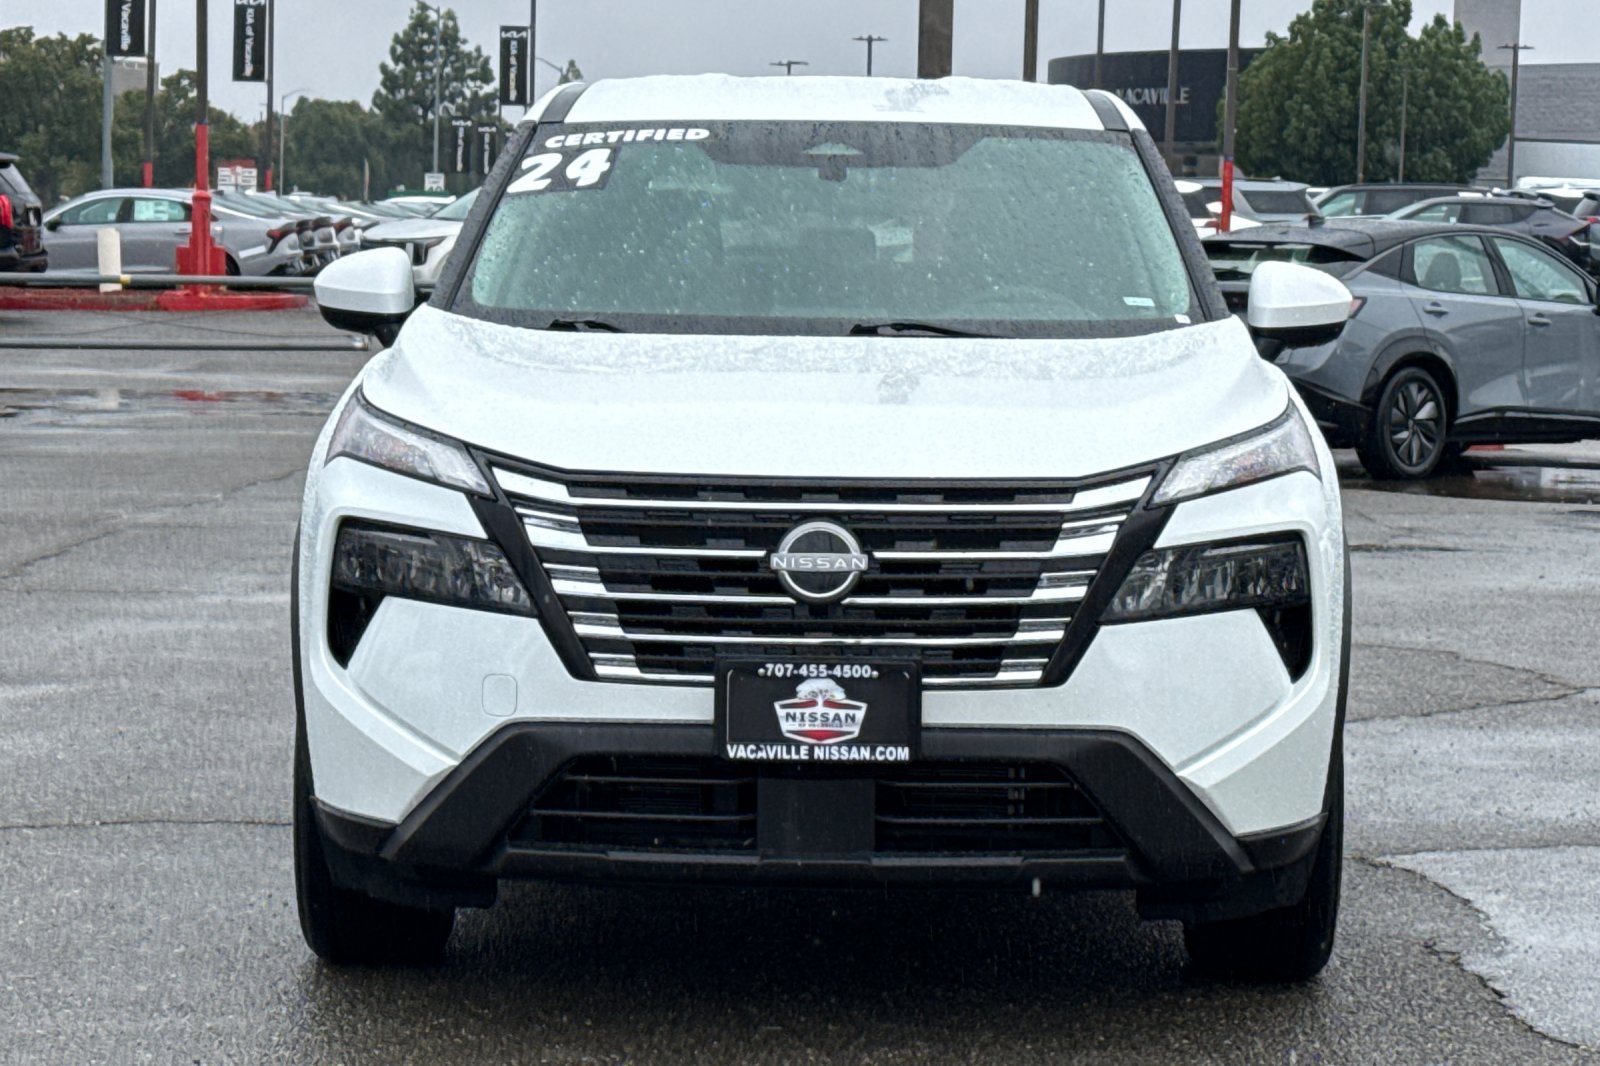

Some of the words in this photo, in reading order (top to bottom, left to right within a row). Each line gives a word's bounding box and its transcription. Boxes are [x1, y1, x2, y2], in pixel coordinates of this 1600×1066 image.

[121, 2, 131, 51] Vacaville
[545, 127, 710, 149] CERTIFIED
[505, 148, 612, 194] 24
[772, 555, 867, 570] NISSAN
[765, 663, 872, 678] 707-455-4500
[785, 711, 857, 724] NISSAN
[726, 744, 810, 760] VACAVILLE
[813, 746, 910, 761] NISSAN.COM
